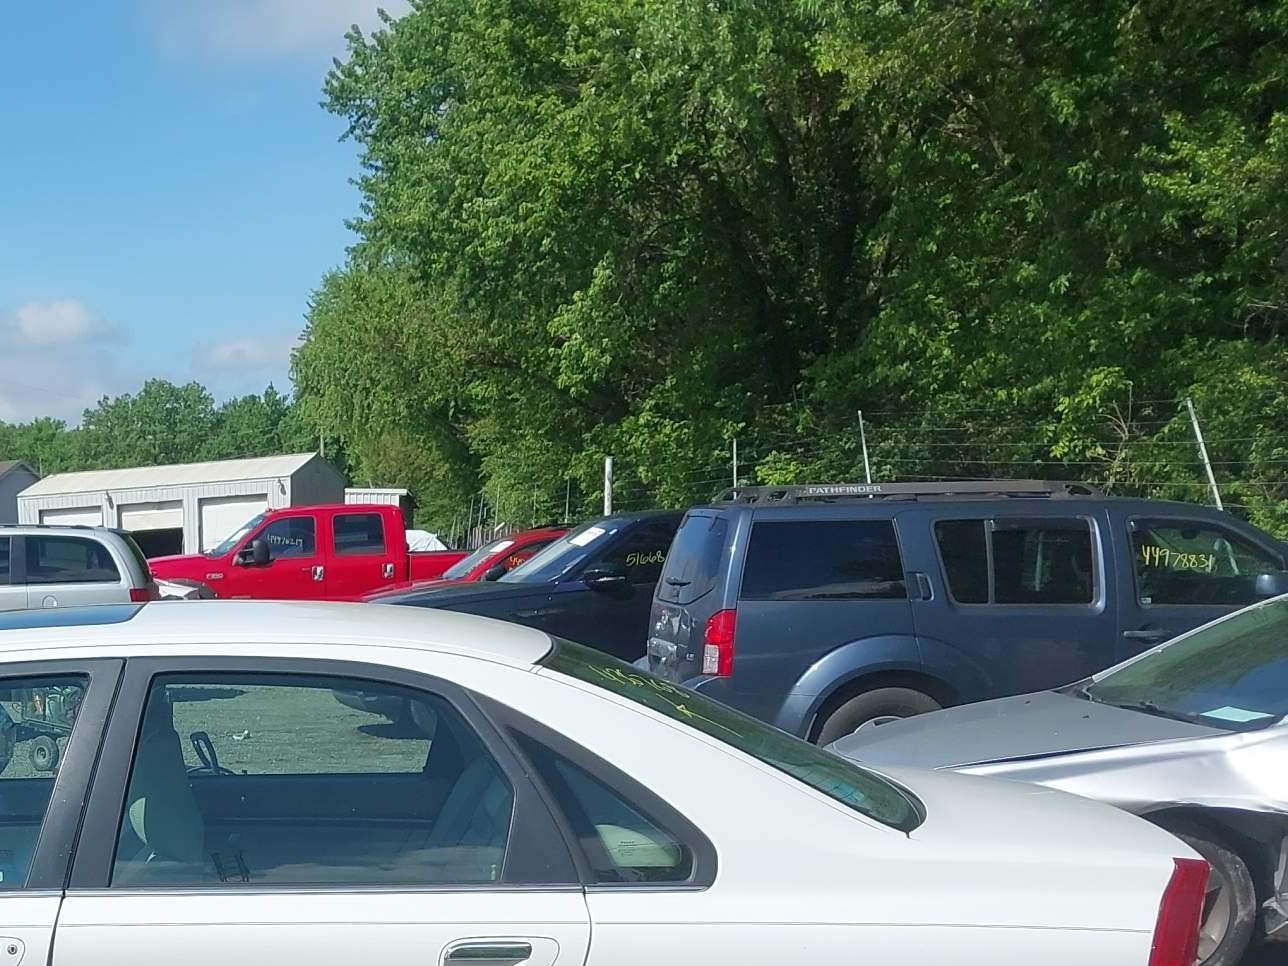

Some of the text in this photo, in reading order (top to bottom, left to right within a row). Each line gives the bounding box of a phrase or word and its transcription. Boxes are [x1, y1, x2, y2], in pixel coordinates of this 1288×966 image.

[808, 485, 883, 494] PATHFINDER
[625, 550, 666, 567] 51668
[1142, 544, 1213, 573] 44978831
